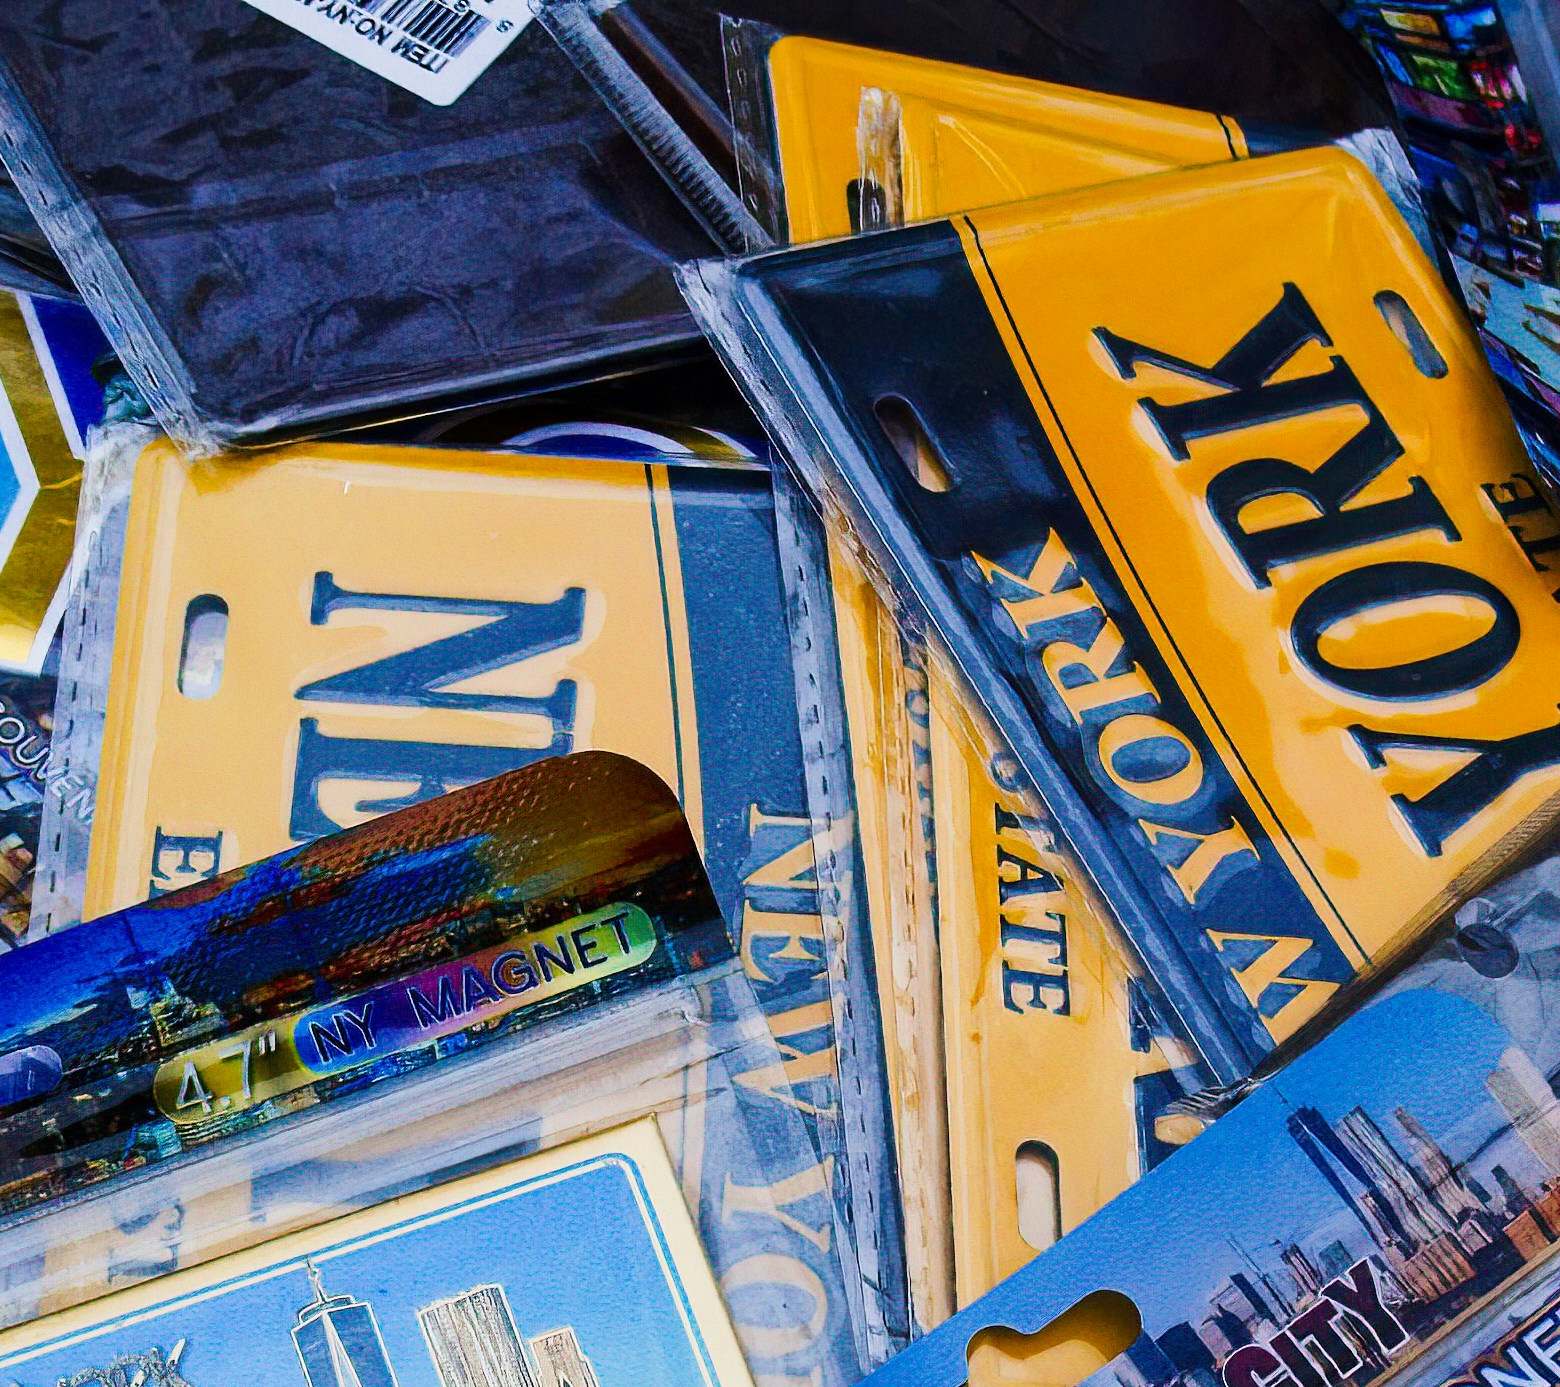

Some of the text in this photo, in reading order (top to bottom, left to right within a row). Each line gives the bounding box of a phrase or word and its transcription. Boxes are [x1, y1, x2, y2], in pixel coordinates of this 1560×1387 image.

[971, 526, 1262, 908] YORK
[309, 1005, 377, 1066] NY
[409, 909, 637, 1025] MAGNET
